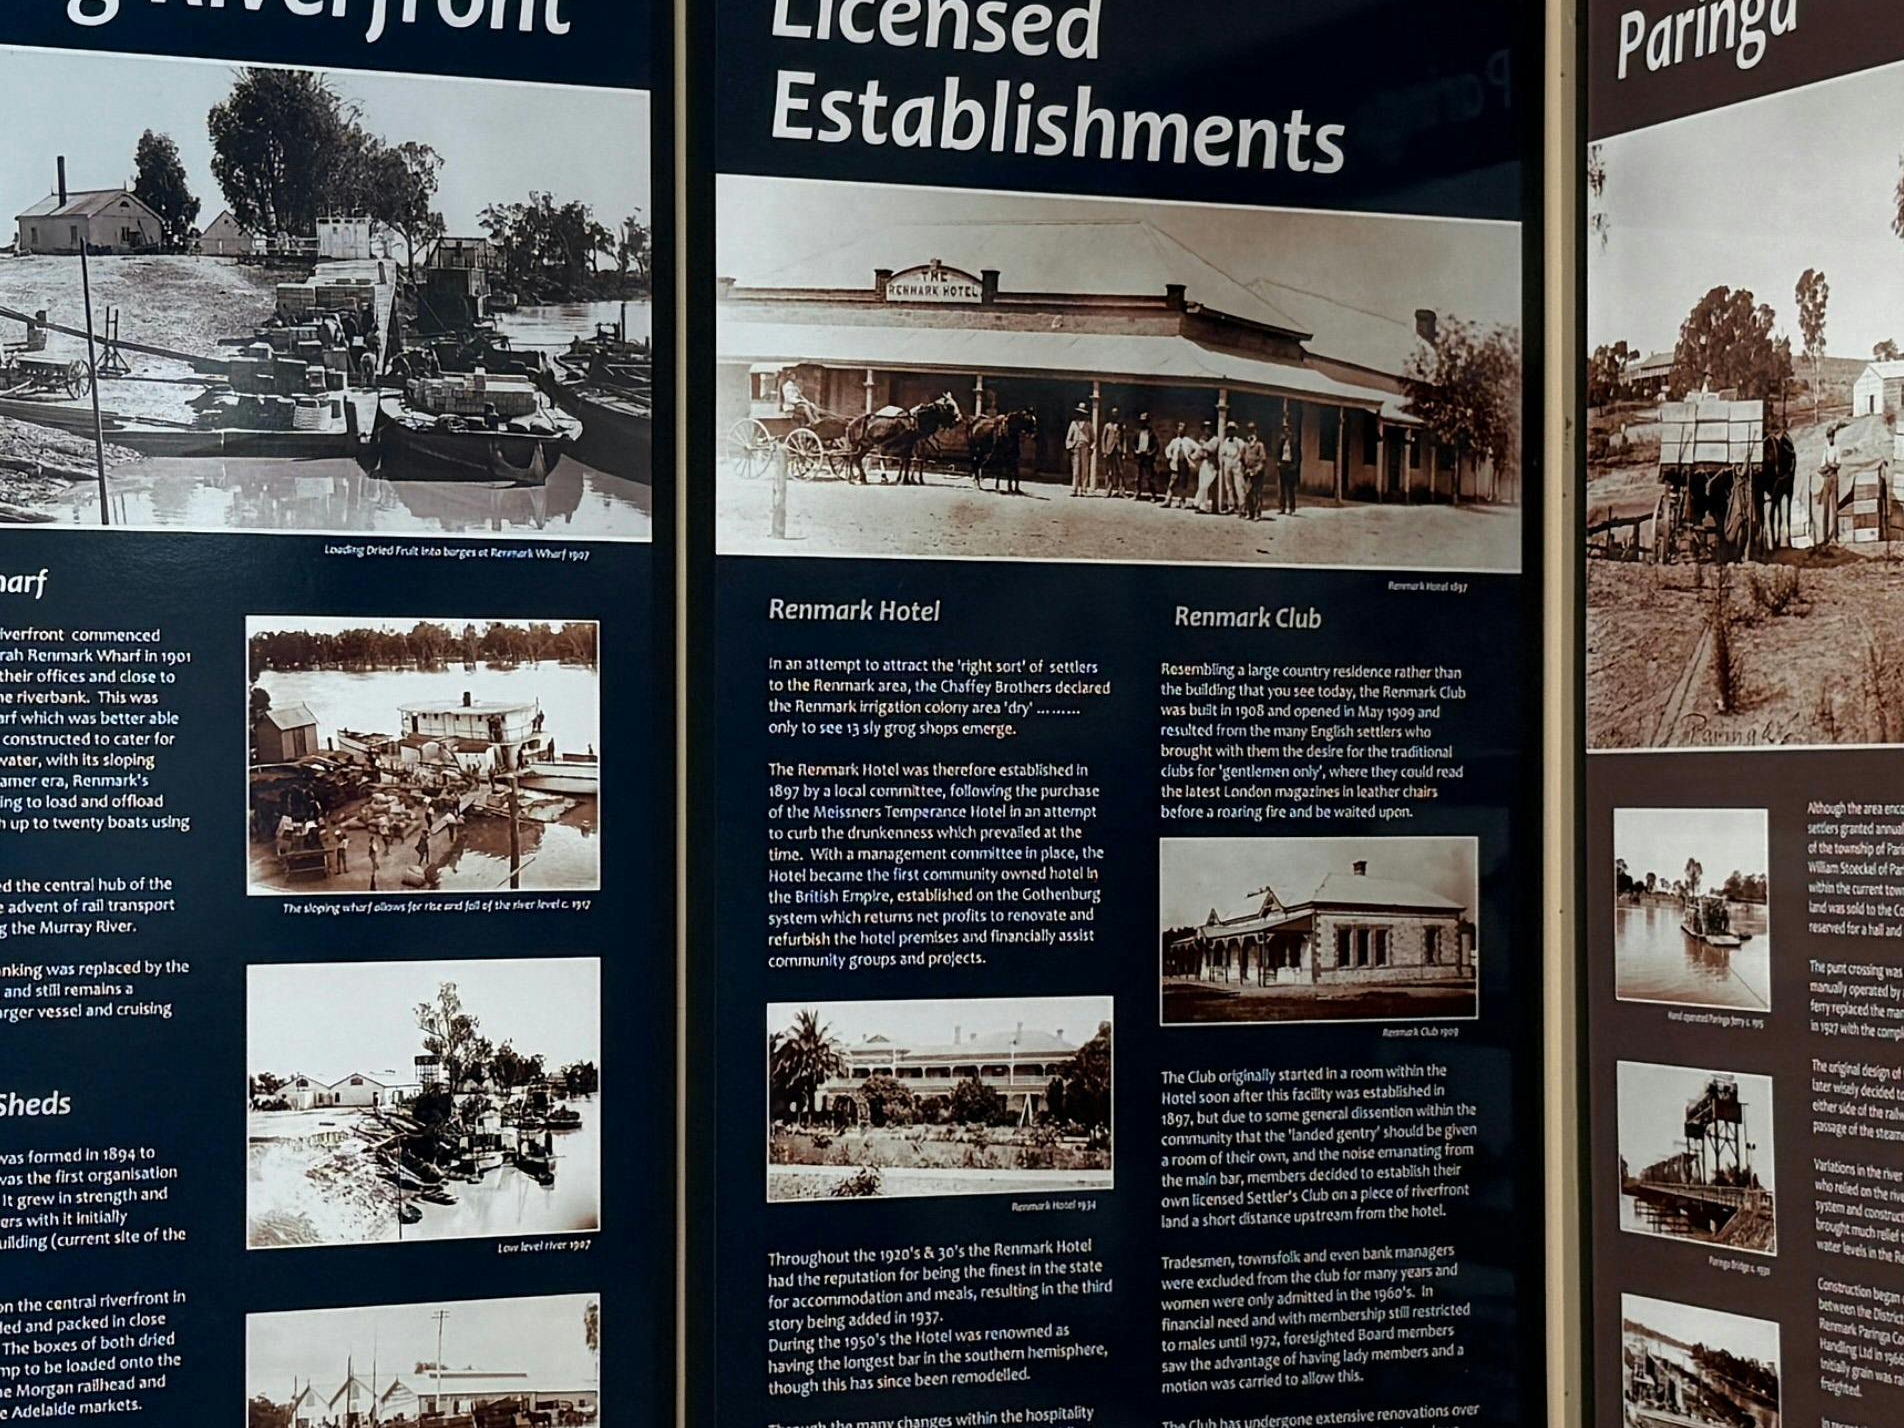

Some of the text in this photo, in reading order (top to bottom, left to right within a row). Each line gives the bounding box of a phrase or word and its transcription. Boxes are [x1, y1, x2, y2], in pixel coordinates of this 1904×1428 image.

[771, 70, 1346, 174] Establishments
[921, 271, 948, 282] THE
[889, 284, 978, 298] RENMARK HOTEL
[769, 598, 941, 622] Renmark Hotel
[1175, 605, 1322, 629] Renmark Club
[768, 719, 1017, 740] only to see 13 sly grog shops emerge.
[1812, 1120, 1848, 1138] passage
[1847, 1121, 1858, 1136] of
[1859, 1124, 1875, 1139] the
